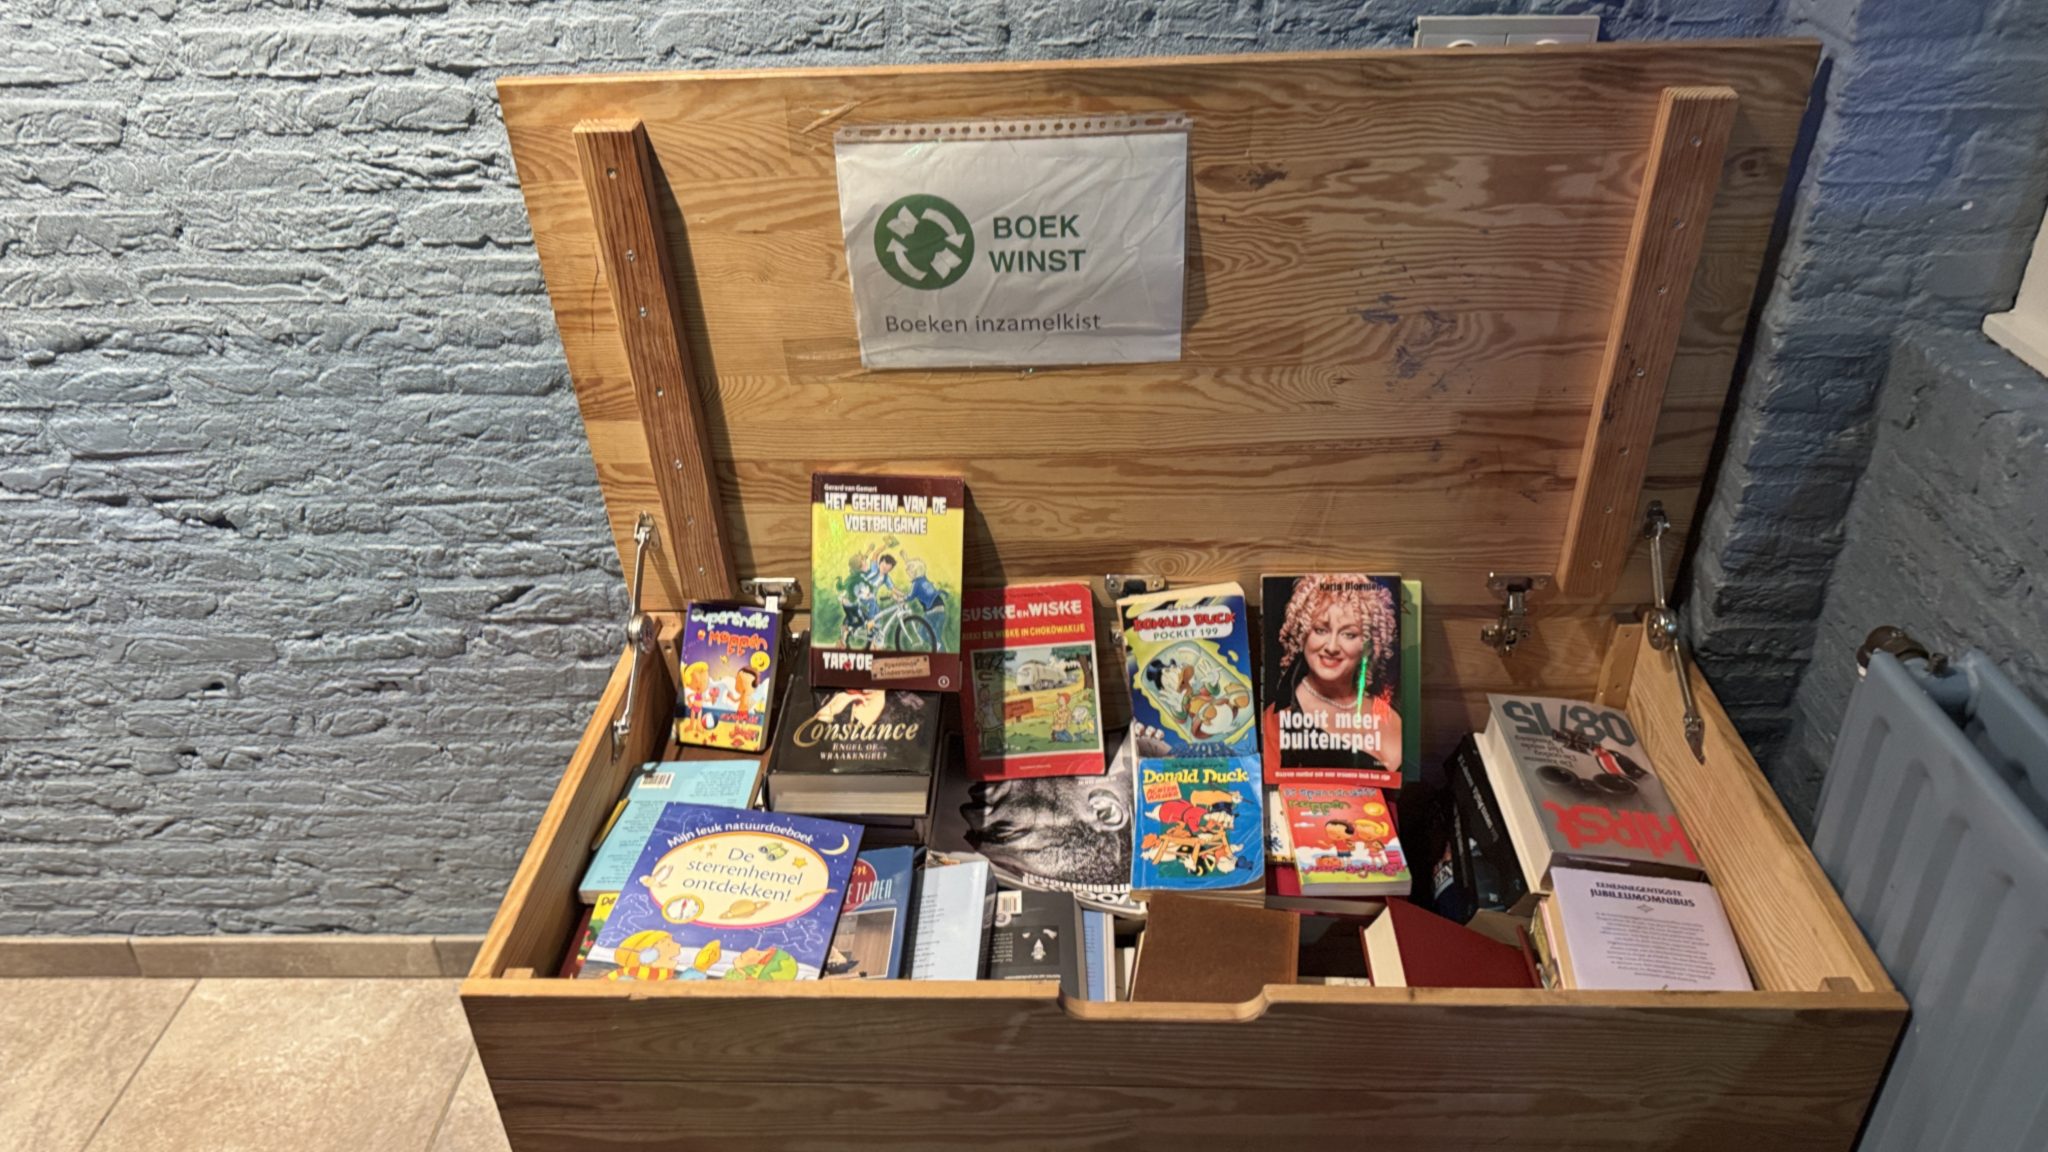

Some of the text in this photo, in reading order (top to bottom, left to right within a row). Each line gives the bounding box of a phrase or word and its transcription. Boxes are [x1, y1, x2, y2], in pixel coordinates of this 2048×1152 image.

[993, 215, 1080, 239] BOEK
[989, 250, 1086, 273] WINST
[885, 313, 1101, 333] Boeken inzamelkist
[824, 483, 844, 491] Gerard
[824, 492, 947, 515] HET GEHEIM VAN DE
[844, 514, 928, 535] VOETBALGAME
[1319, 582, 1342, 592] Karin
[962, 604, 1016, 622] SUSKE
[1028, 600, 1082, 617] WISKE
[1133, 612, 1236, 632] DONALD DUCK
[995, 629, 1019, 639] WISKE
[1021, 629, 1029, 637] IN
[1153, 628, 1219, 640] POCKET 199
[1279, 710, 1381, 730] Nooit meer
[793, 716, 920, 748] Constance
[1279, 729, 1381, 753] buitenspel
[820, 752, 887, 761] WRAAKENGEL?
[832, 743, 863, 751] ENGEL
[1143, 768, 1249, 784] Donald Duck
[666, 822, 814, 848] Mijn leuk natuurdoeboek
[728, 847, 755, 862] De
[687, 860, 803, 885] sterrenhemel
[682, 878, 792, 901] ontdekken!
[856, 879, 893, 903] TIJDEN
[1590, 888, 1696, 907] JUBILEUMOMNIBUS
